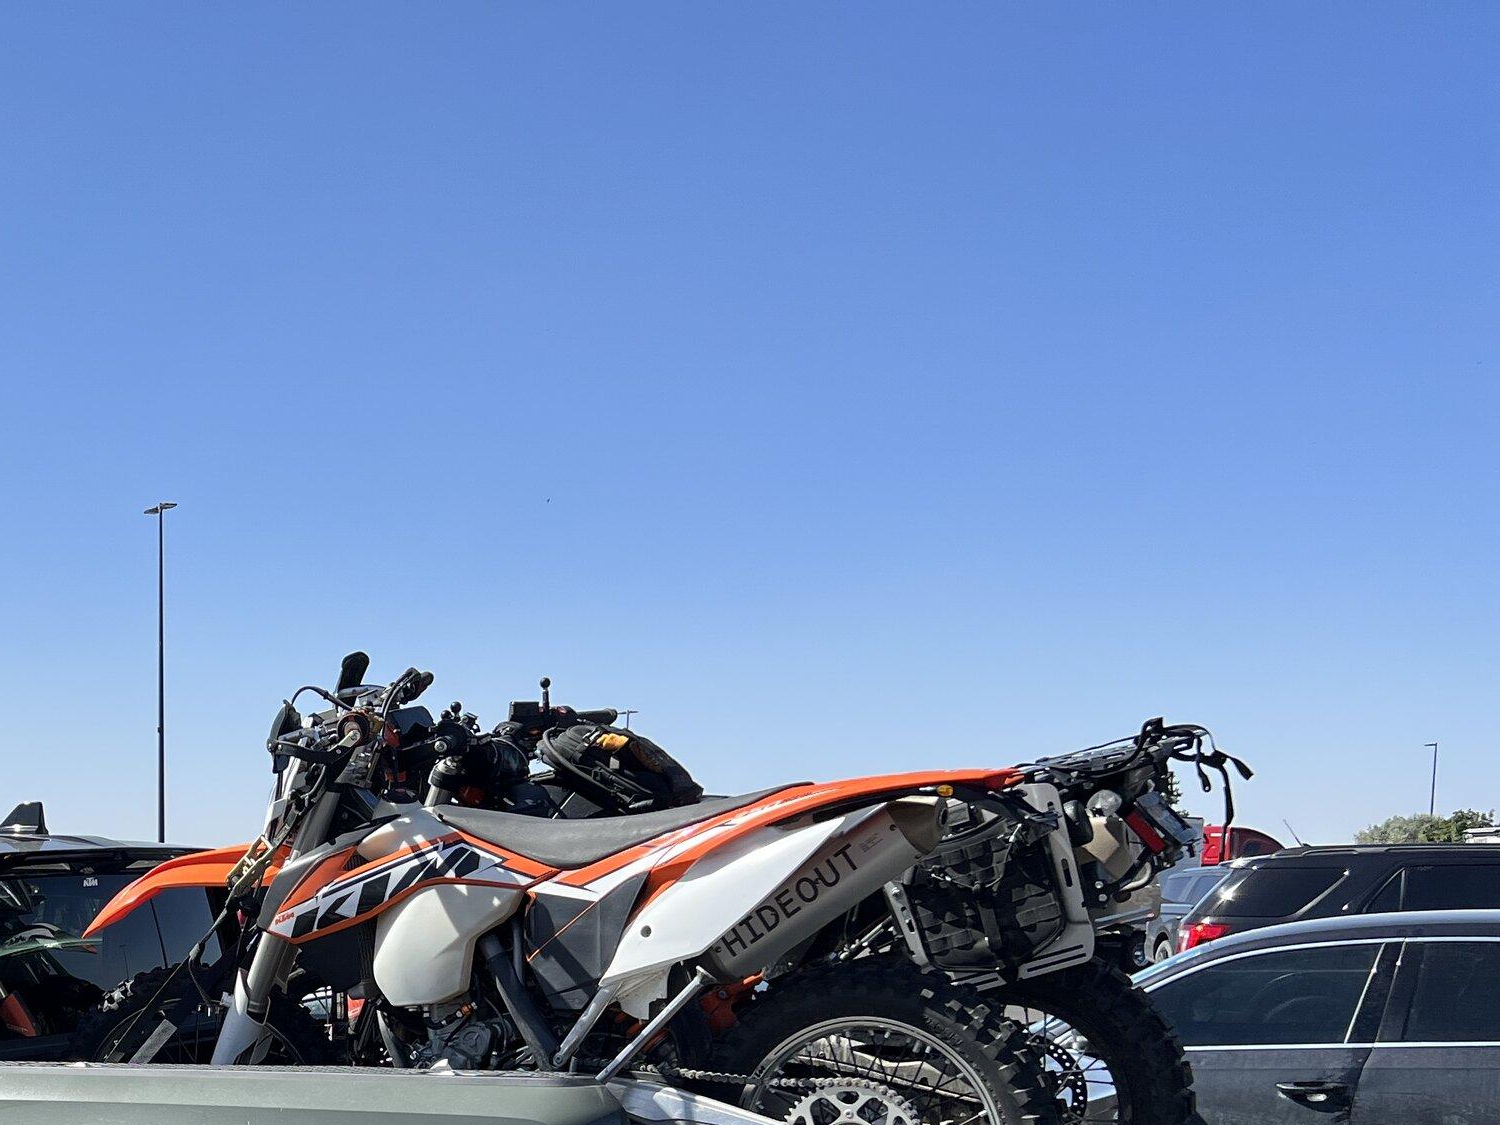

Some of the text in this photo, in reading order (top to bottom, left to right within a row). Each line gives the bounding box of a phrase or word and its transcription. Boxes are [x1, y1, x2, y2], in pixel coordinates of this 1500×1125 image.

[83, 877, 98, 887] KTM
[291, 846, 481, 938] KTM
[721, 843, 858, 957] HIDEOUT
